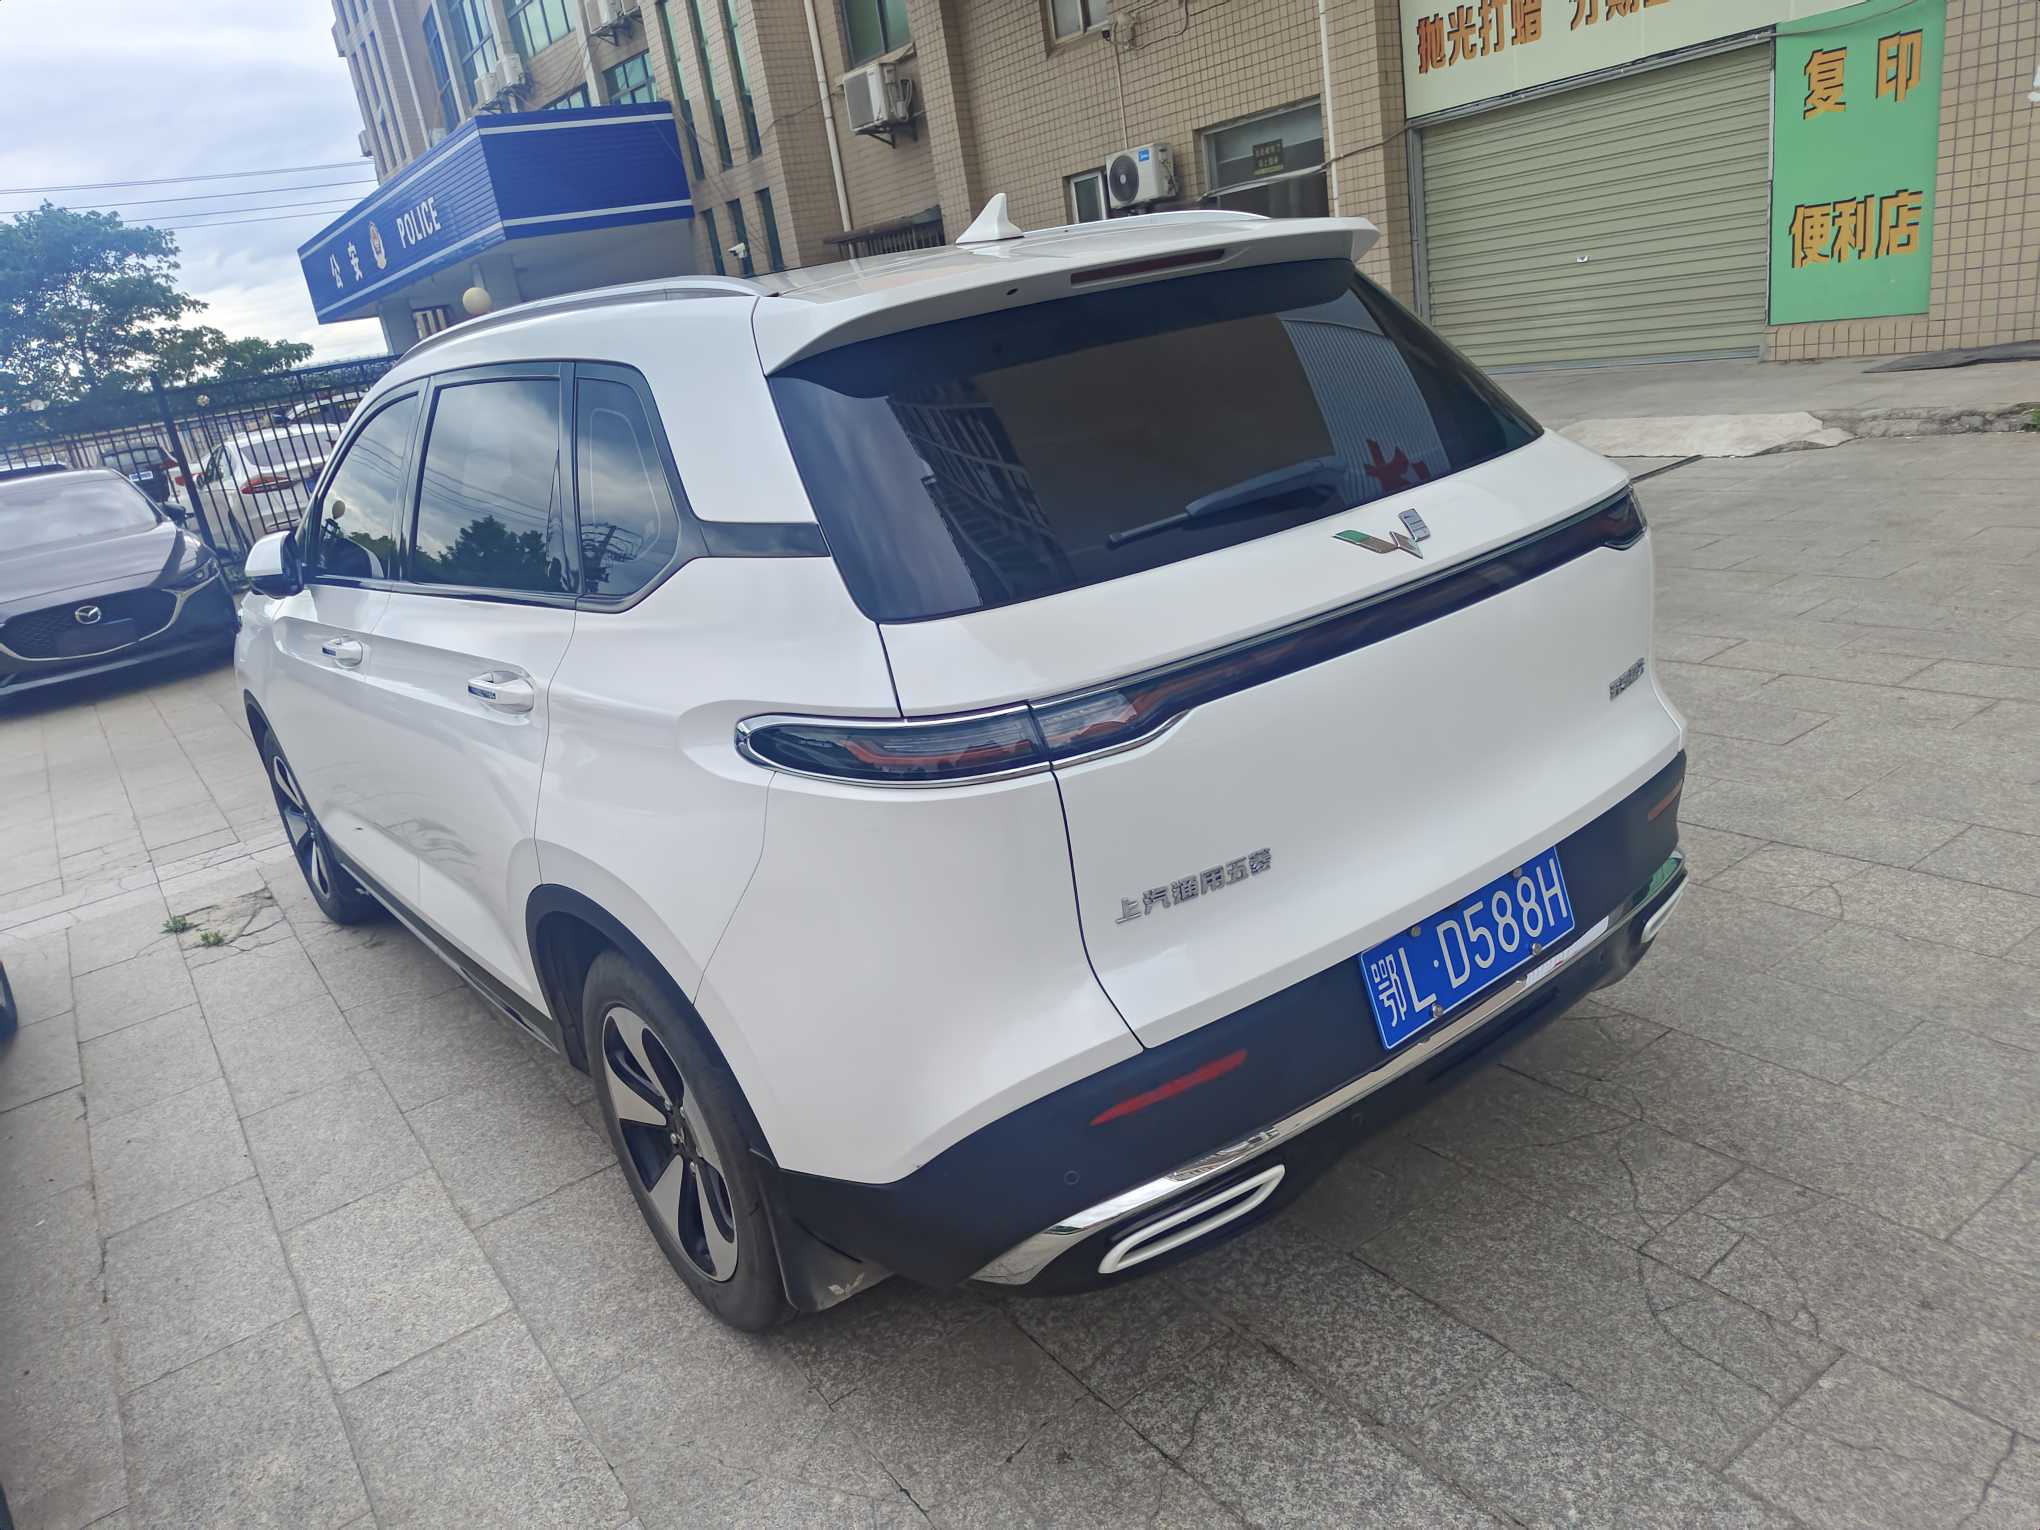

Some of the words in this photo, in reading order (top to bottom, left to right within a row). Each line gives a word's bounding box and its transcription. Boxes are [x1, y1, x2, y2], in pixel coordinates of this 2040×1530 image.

[1803, 30, 1923, 120] 复印
[330, 241, 363, 289] 公安
[396, 197, 441, 249] POLICE
[1789, 189, 1923, 268] 便利店
